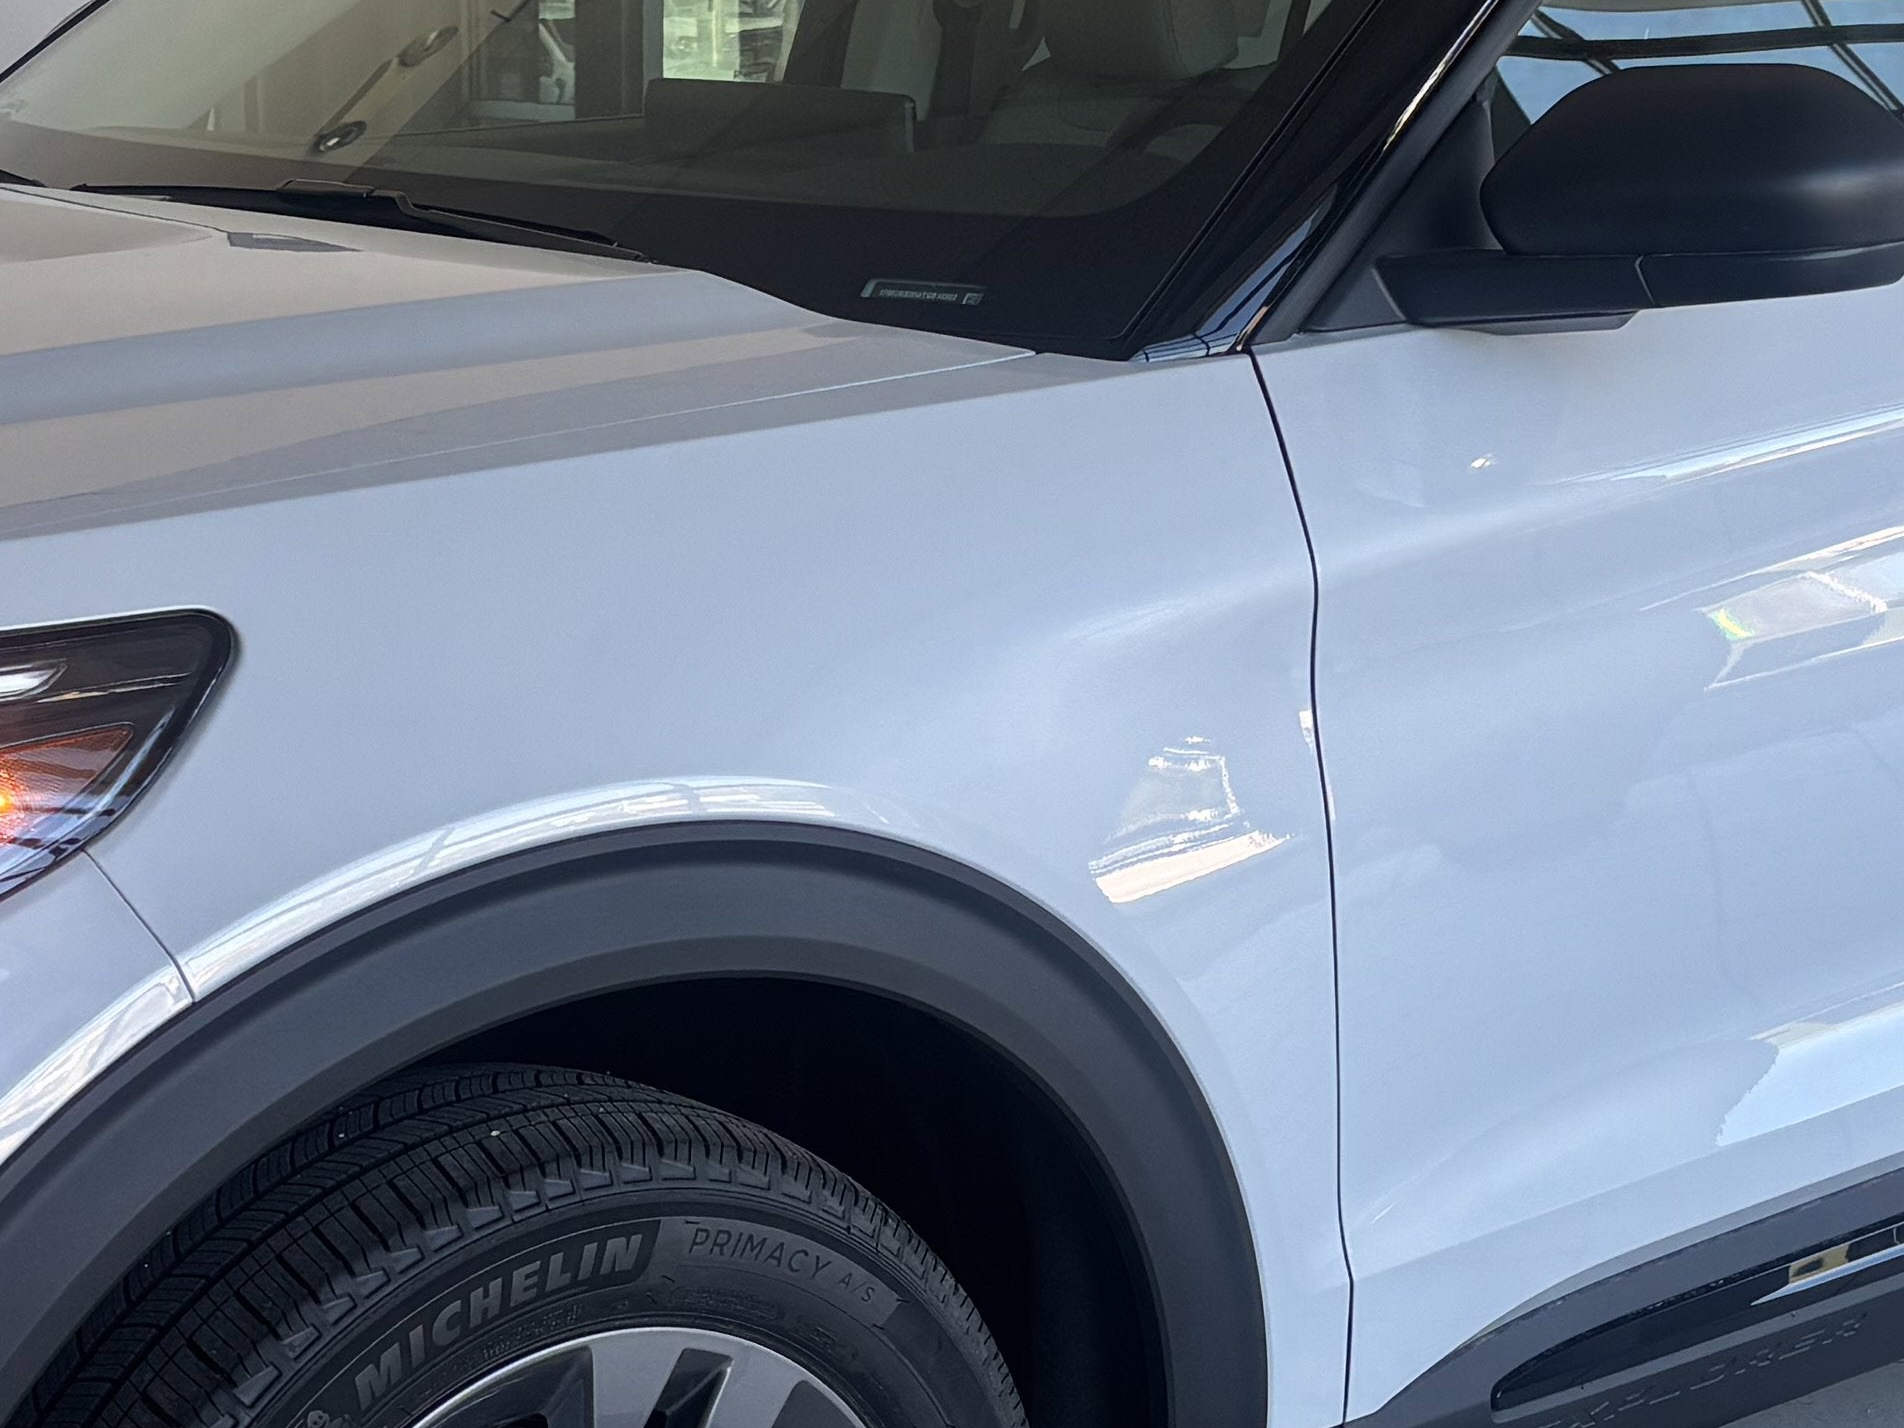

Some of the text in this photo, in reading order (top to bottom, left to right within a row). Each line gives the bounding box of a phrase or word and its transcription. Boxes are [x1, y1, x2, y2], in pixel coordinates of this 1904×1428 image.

[353, 1233, 643, 1412] MICHELIN
[688, 1227, 877, 1304] PRIMACY A/S
